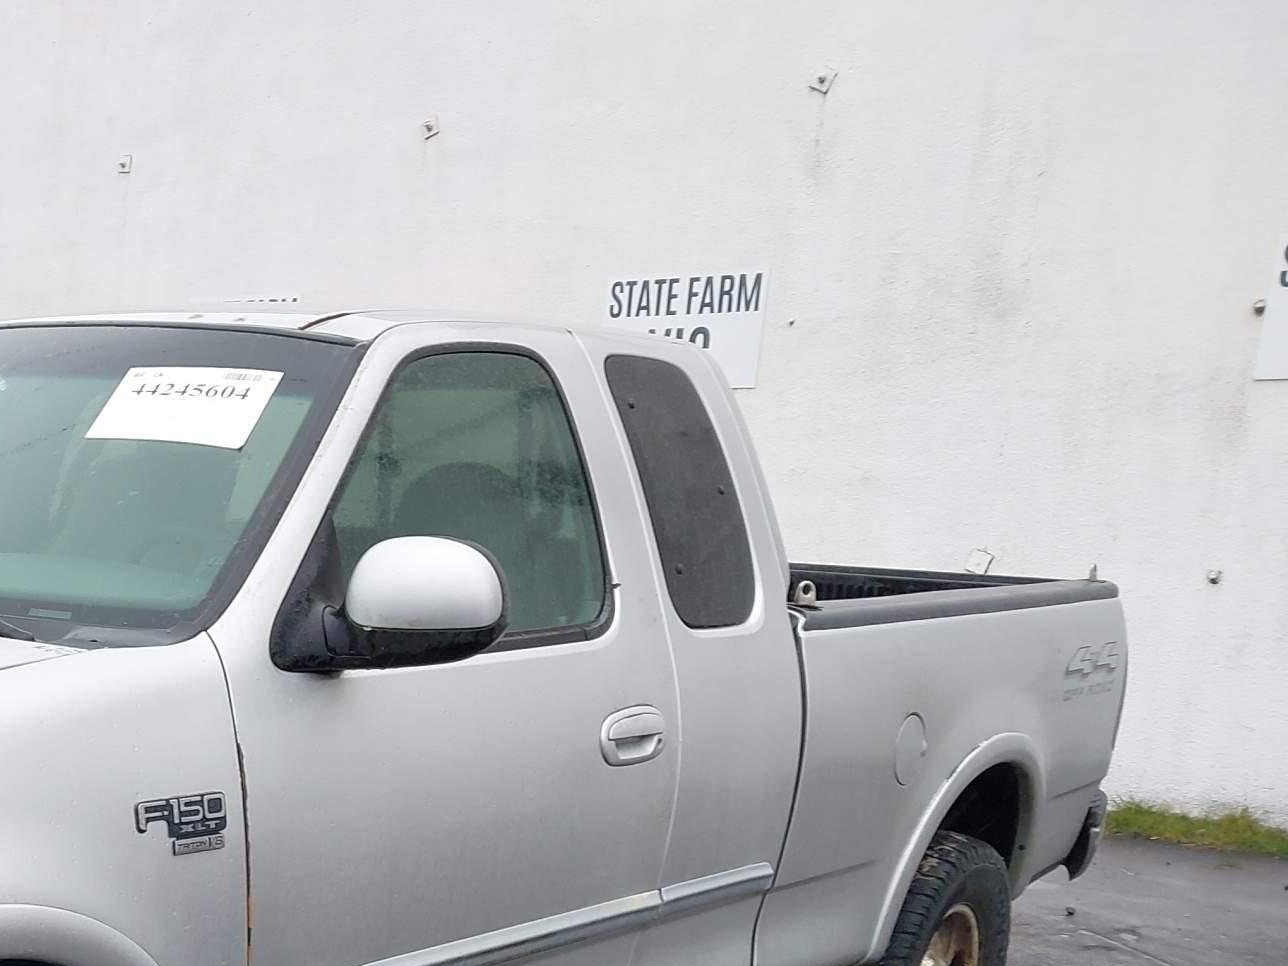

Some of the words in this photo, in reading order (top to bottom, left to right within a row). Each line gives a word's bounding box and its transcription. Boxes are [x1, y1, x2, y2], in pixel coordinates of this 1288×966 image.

[608, 278, 681, 319] STATE
[686, 272, 764, 315] FARM
[131, 382, 252, 400] 44245604
[179, 820, 222, 833] XLT
